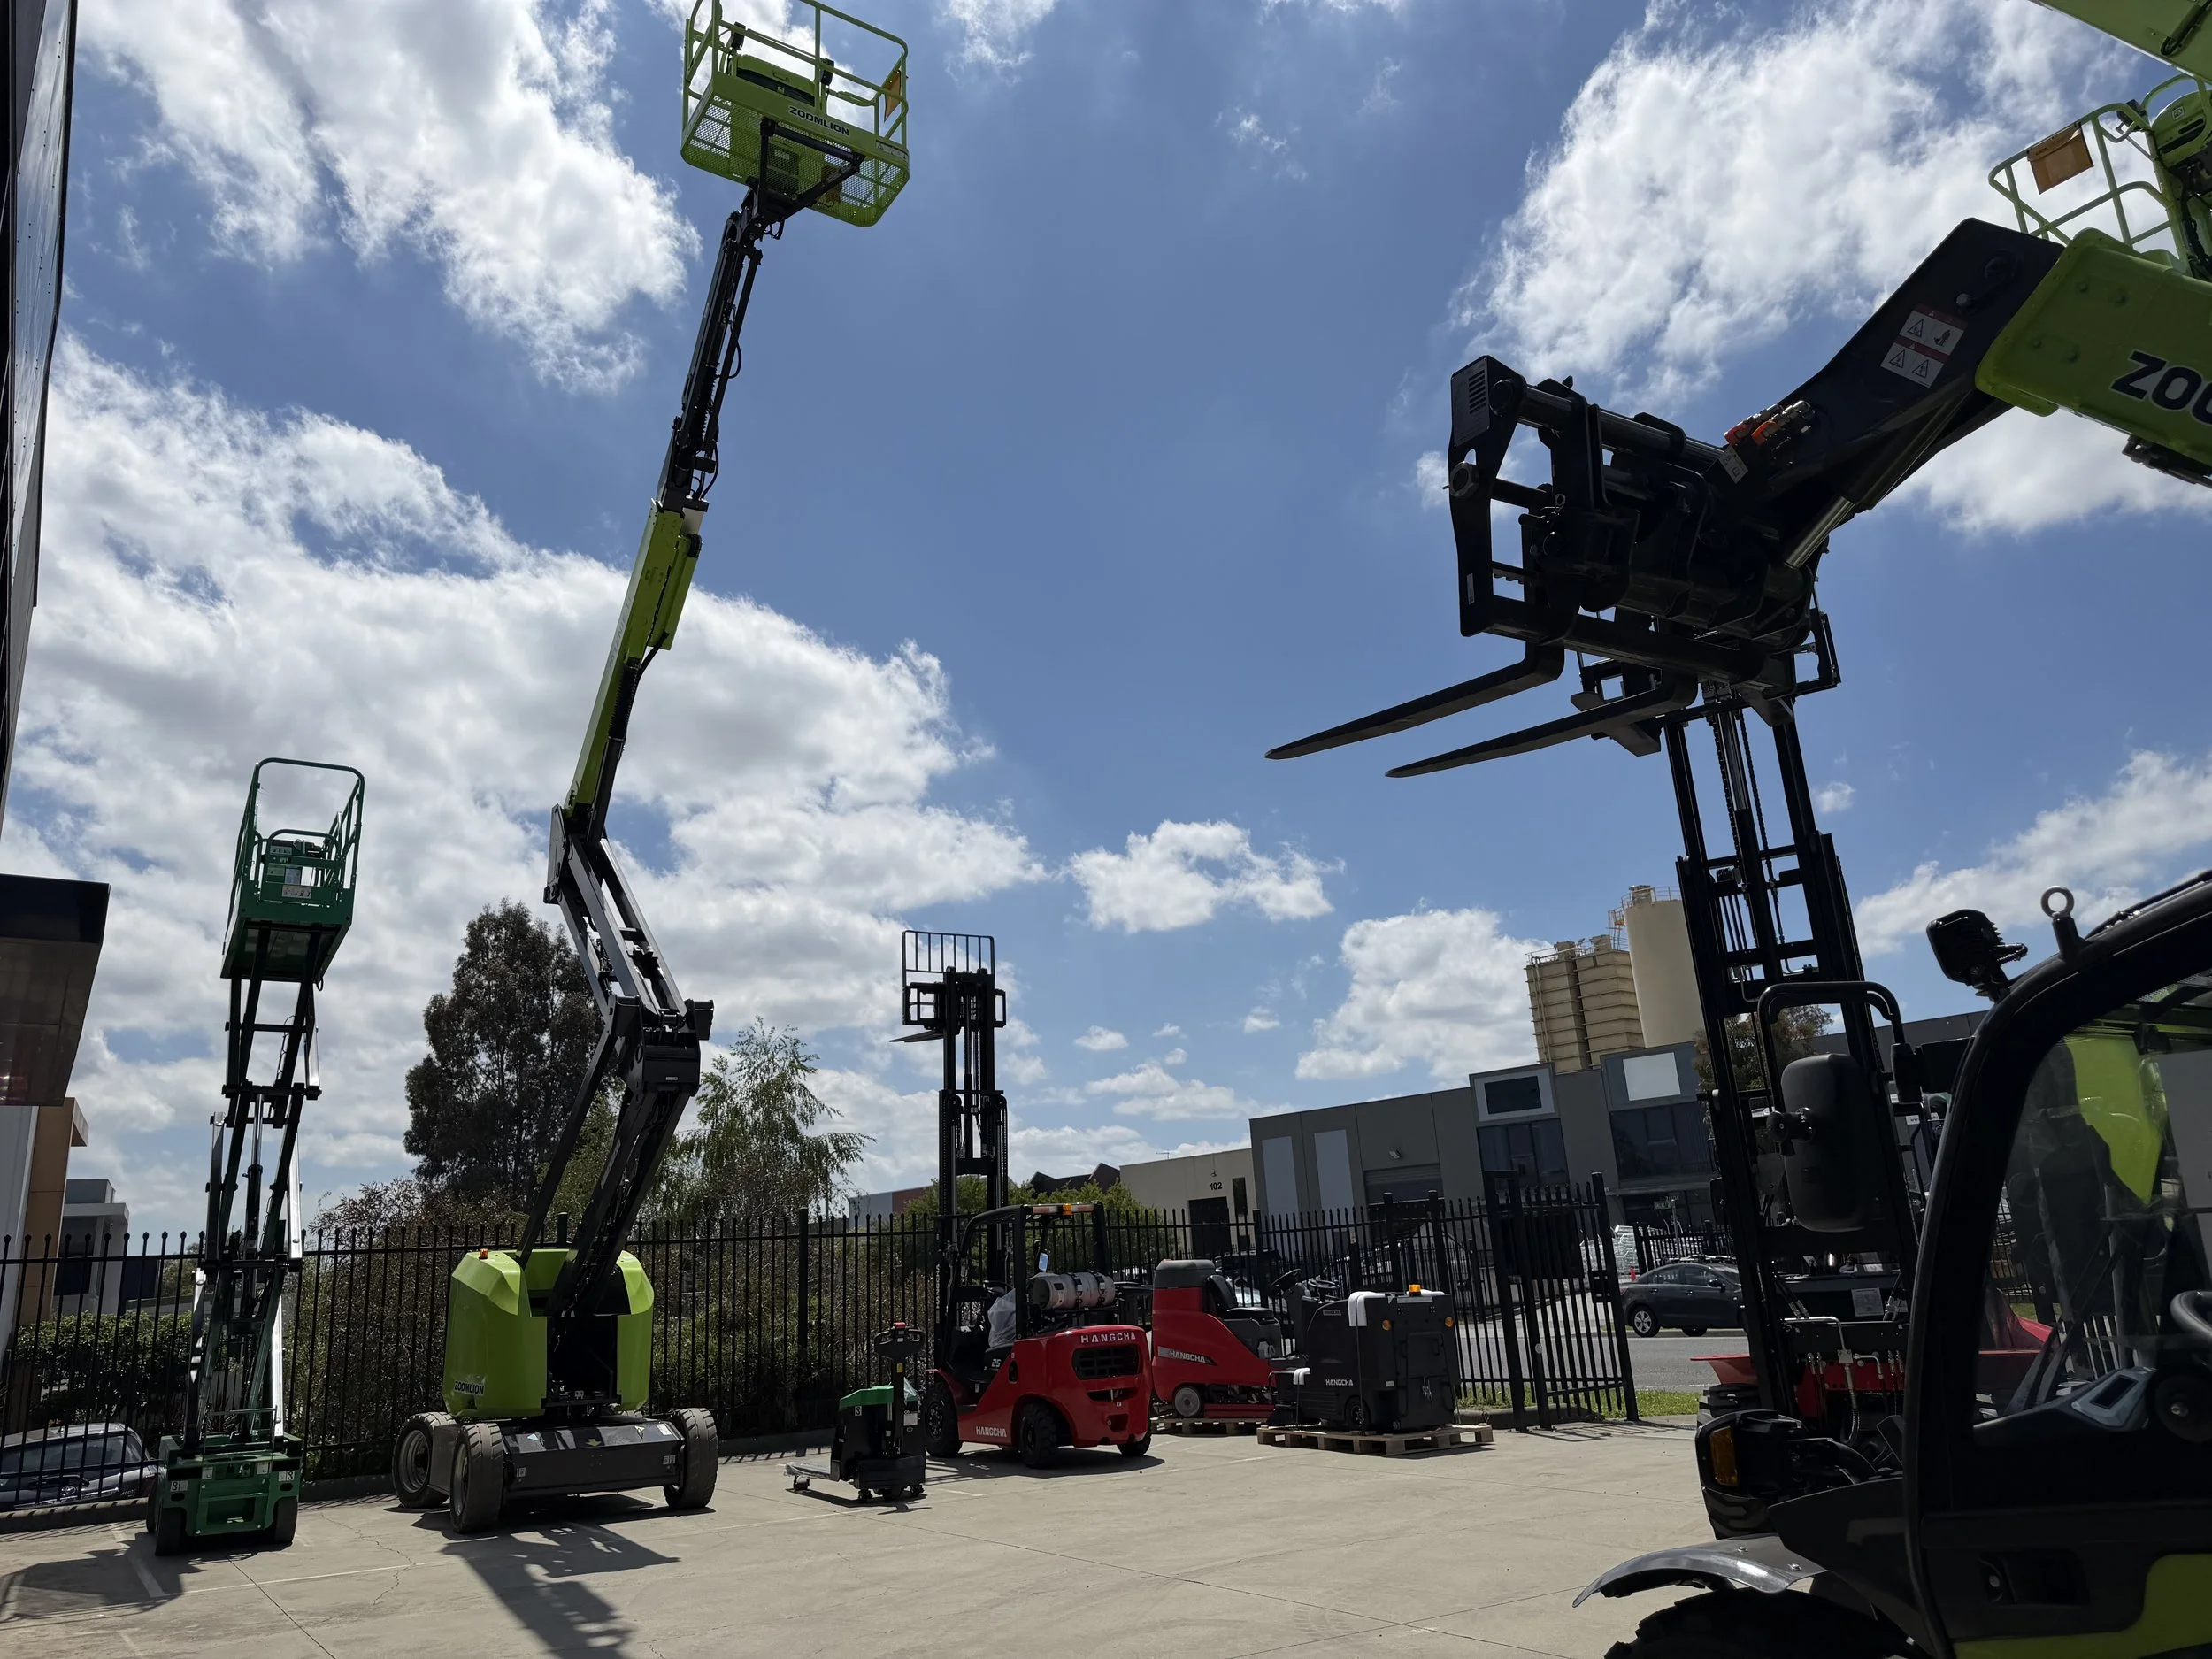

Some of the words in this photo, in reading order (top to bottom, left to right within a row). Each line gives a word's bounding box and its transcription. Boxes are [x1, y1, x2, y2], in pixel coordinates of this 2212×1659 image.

[789, 105, 849, 135] ZOOMLION
[1210, 1182, 1223, 1191] 102
[1080, 1332, 1136, 1343] HANGCHA
[1170, 1349, 1206, 1363] HANGCHA
[454, 1380, 485, 1395] ZOOMLION
[976, 1425, 1008, 1438] HANGCHA
